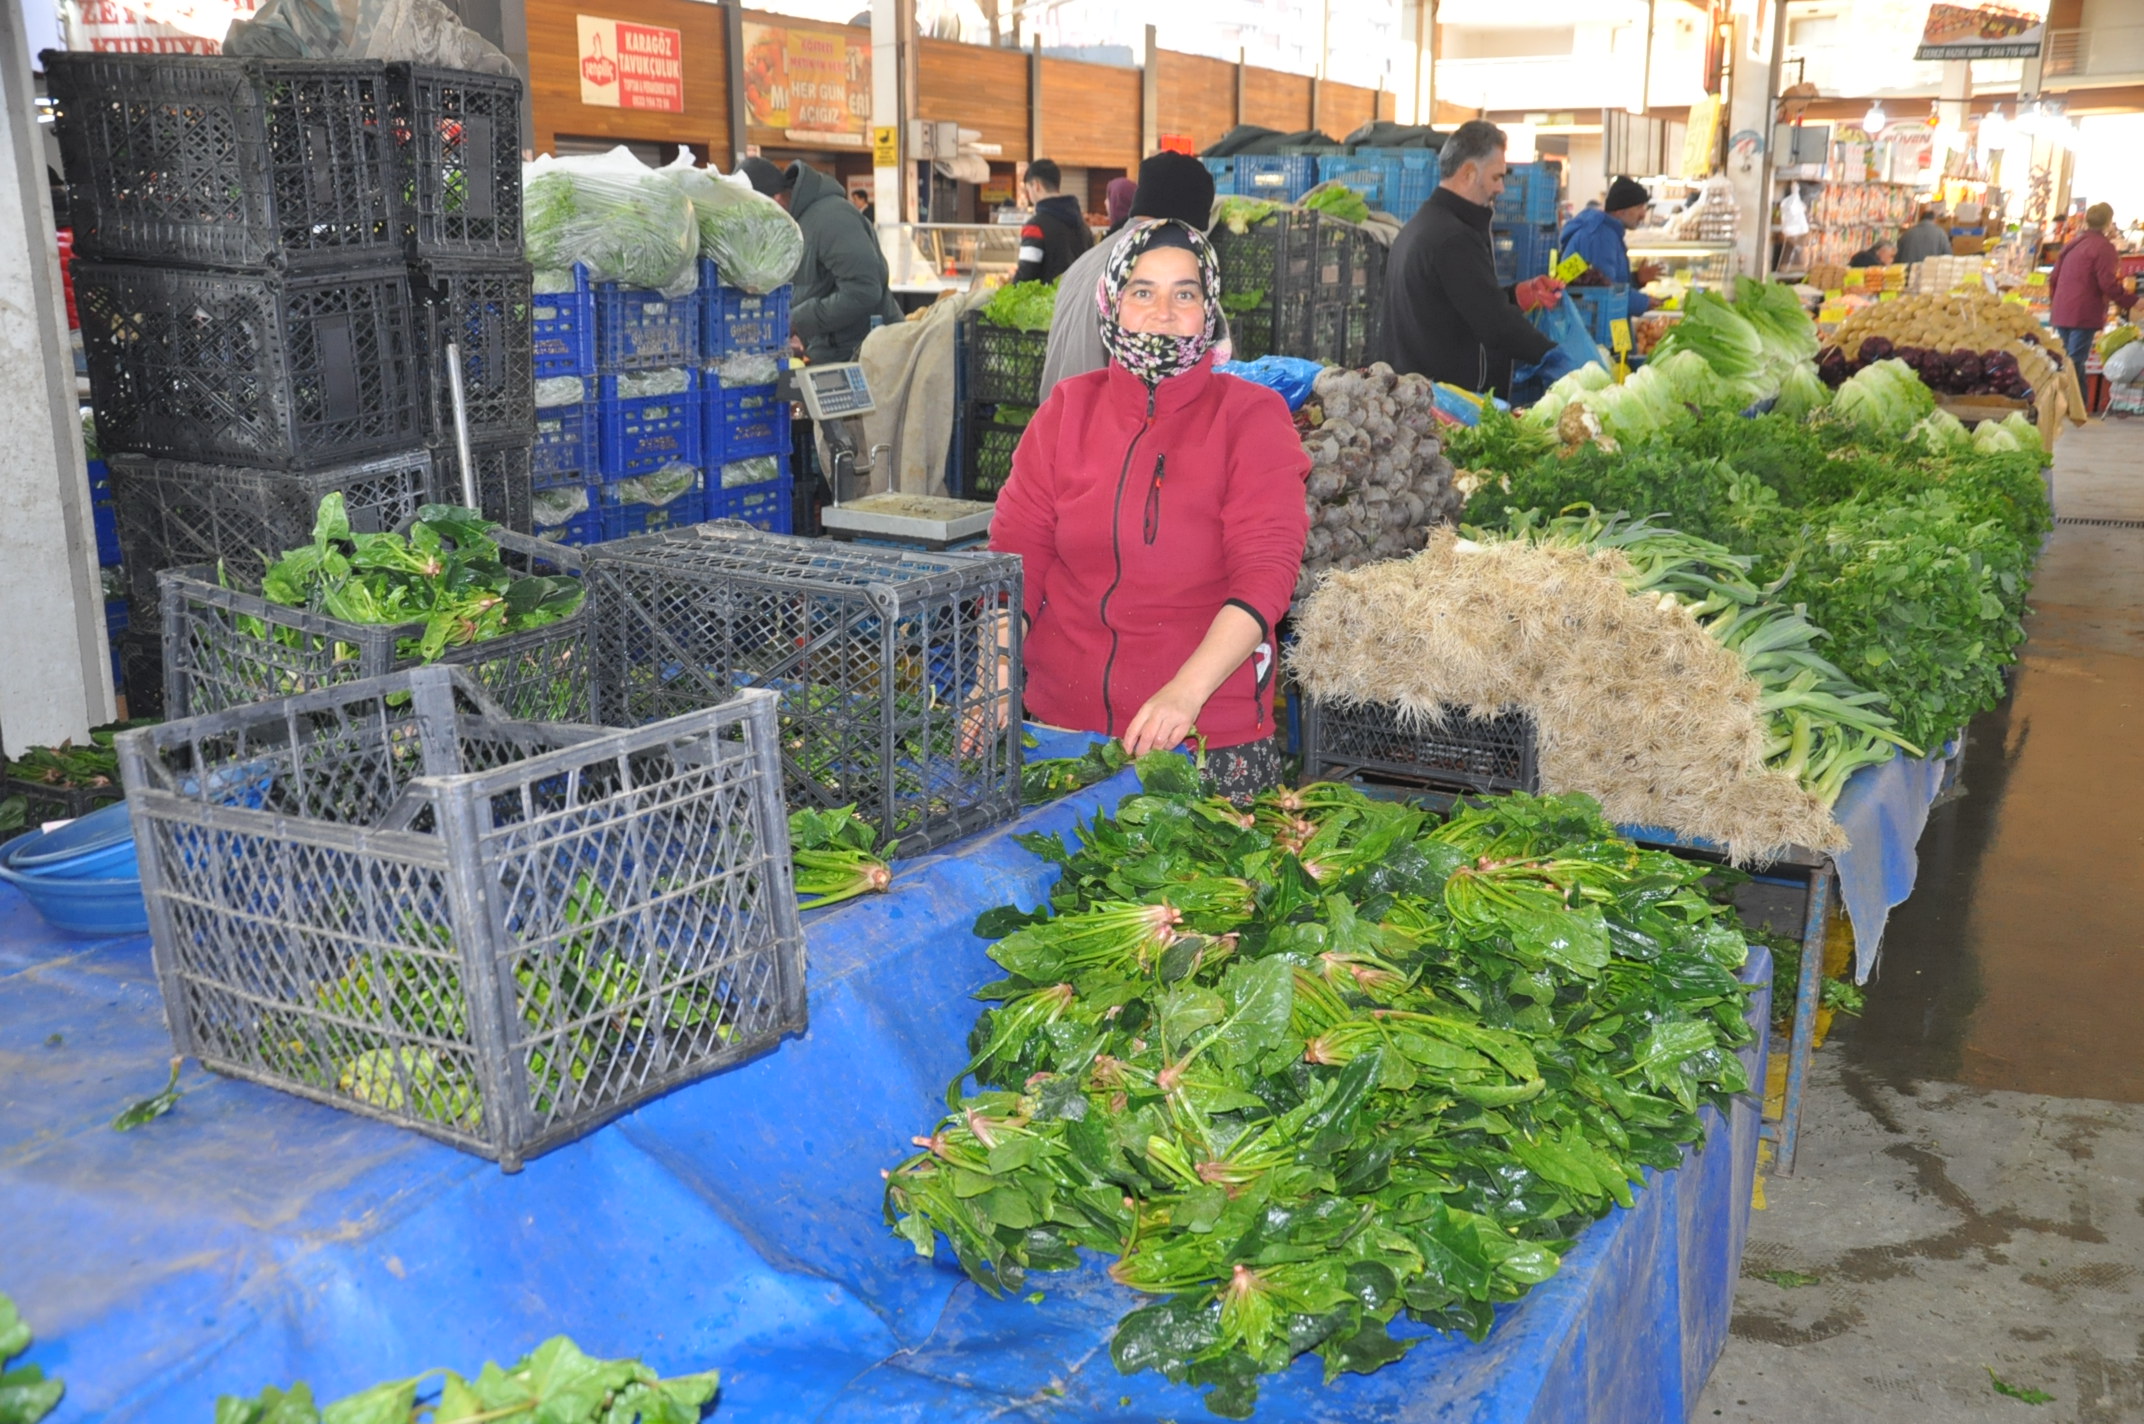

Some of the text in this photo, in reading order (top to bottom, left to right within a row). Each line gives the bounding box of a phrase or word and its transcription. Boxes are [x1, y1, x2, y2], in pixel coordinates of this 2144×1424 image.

[624, 31, 672, 56] KARAGÖZ
[618, 52, 679, 79] TAVUKÇULUK
[791, 80, 817, 100] HER
[819, 79, 846, 102] GÜN
[799, 104, 840, 125] AÇIĞIZ
